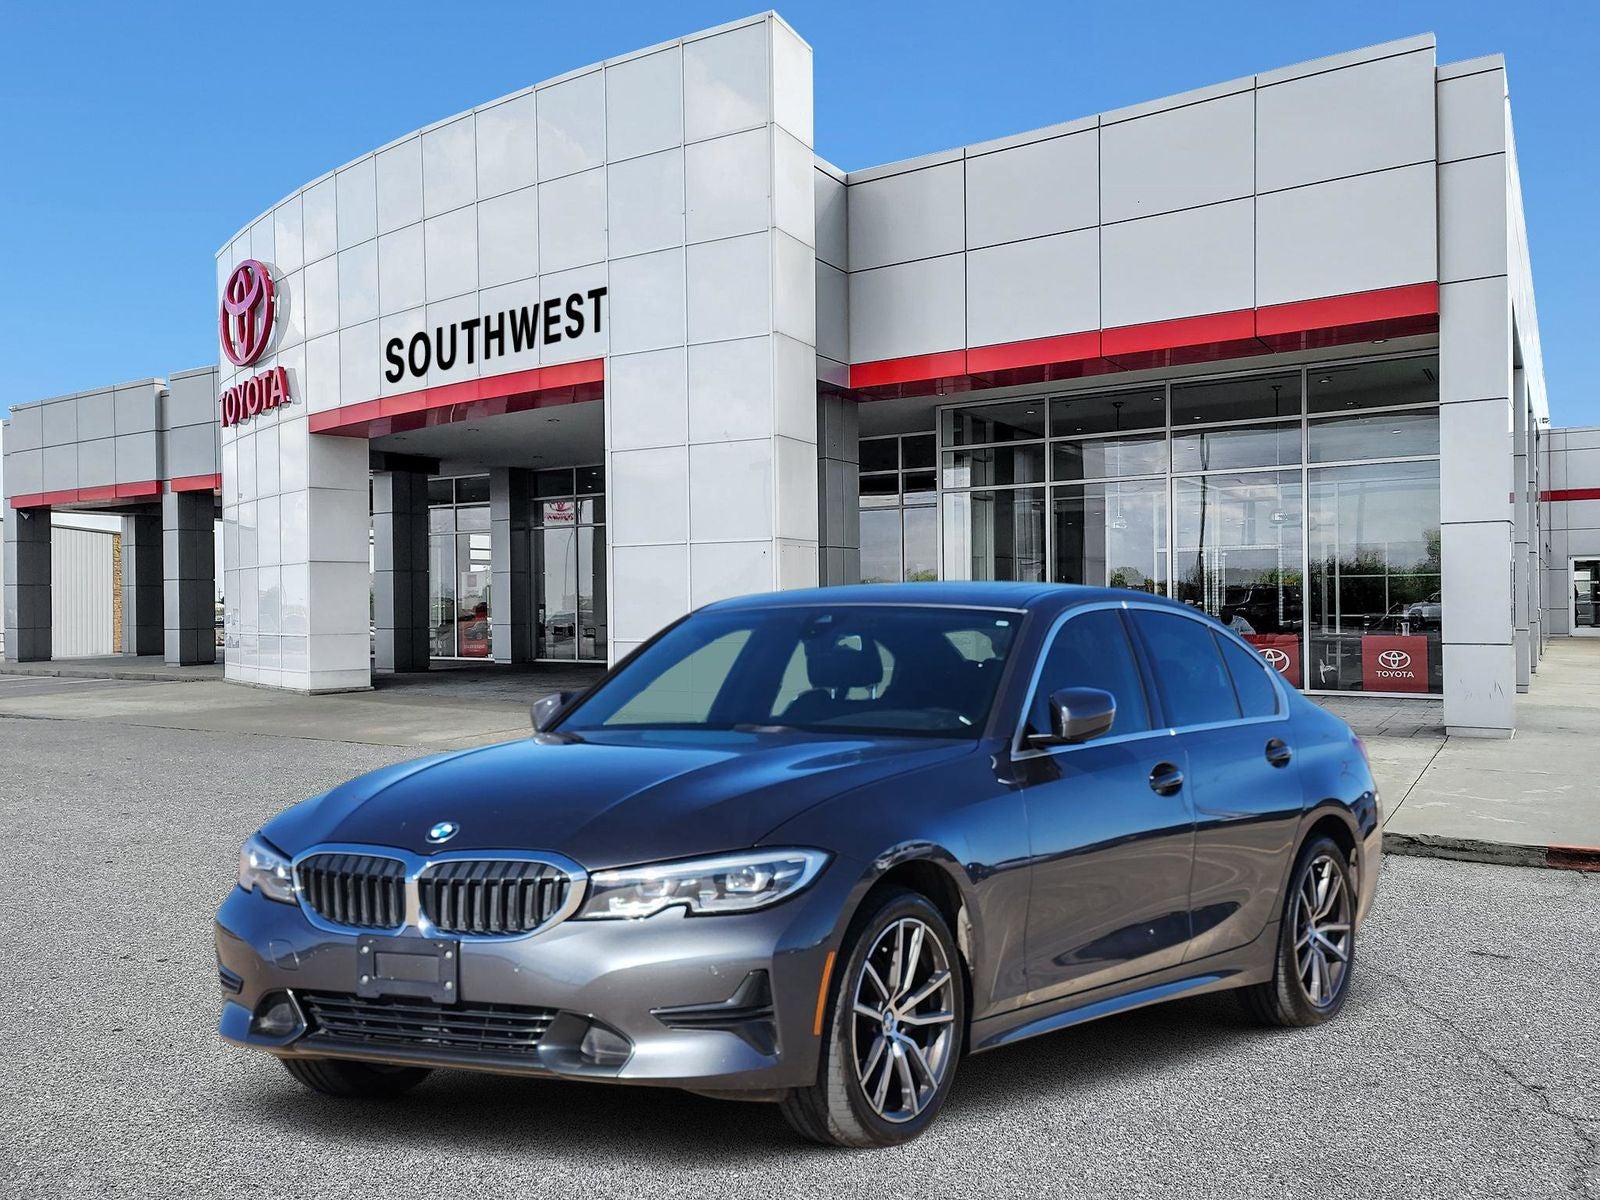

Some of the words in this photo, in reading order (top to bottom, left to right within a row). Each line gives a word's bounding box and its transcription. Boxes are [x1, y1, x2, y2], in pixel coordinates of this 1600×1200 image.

[385, 286, 608, 383] SOUTHWEST
[218, 366, 291, 428] TOYOTA
[1376, 670, 1414, 678] TOYOTA
